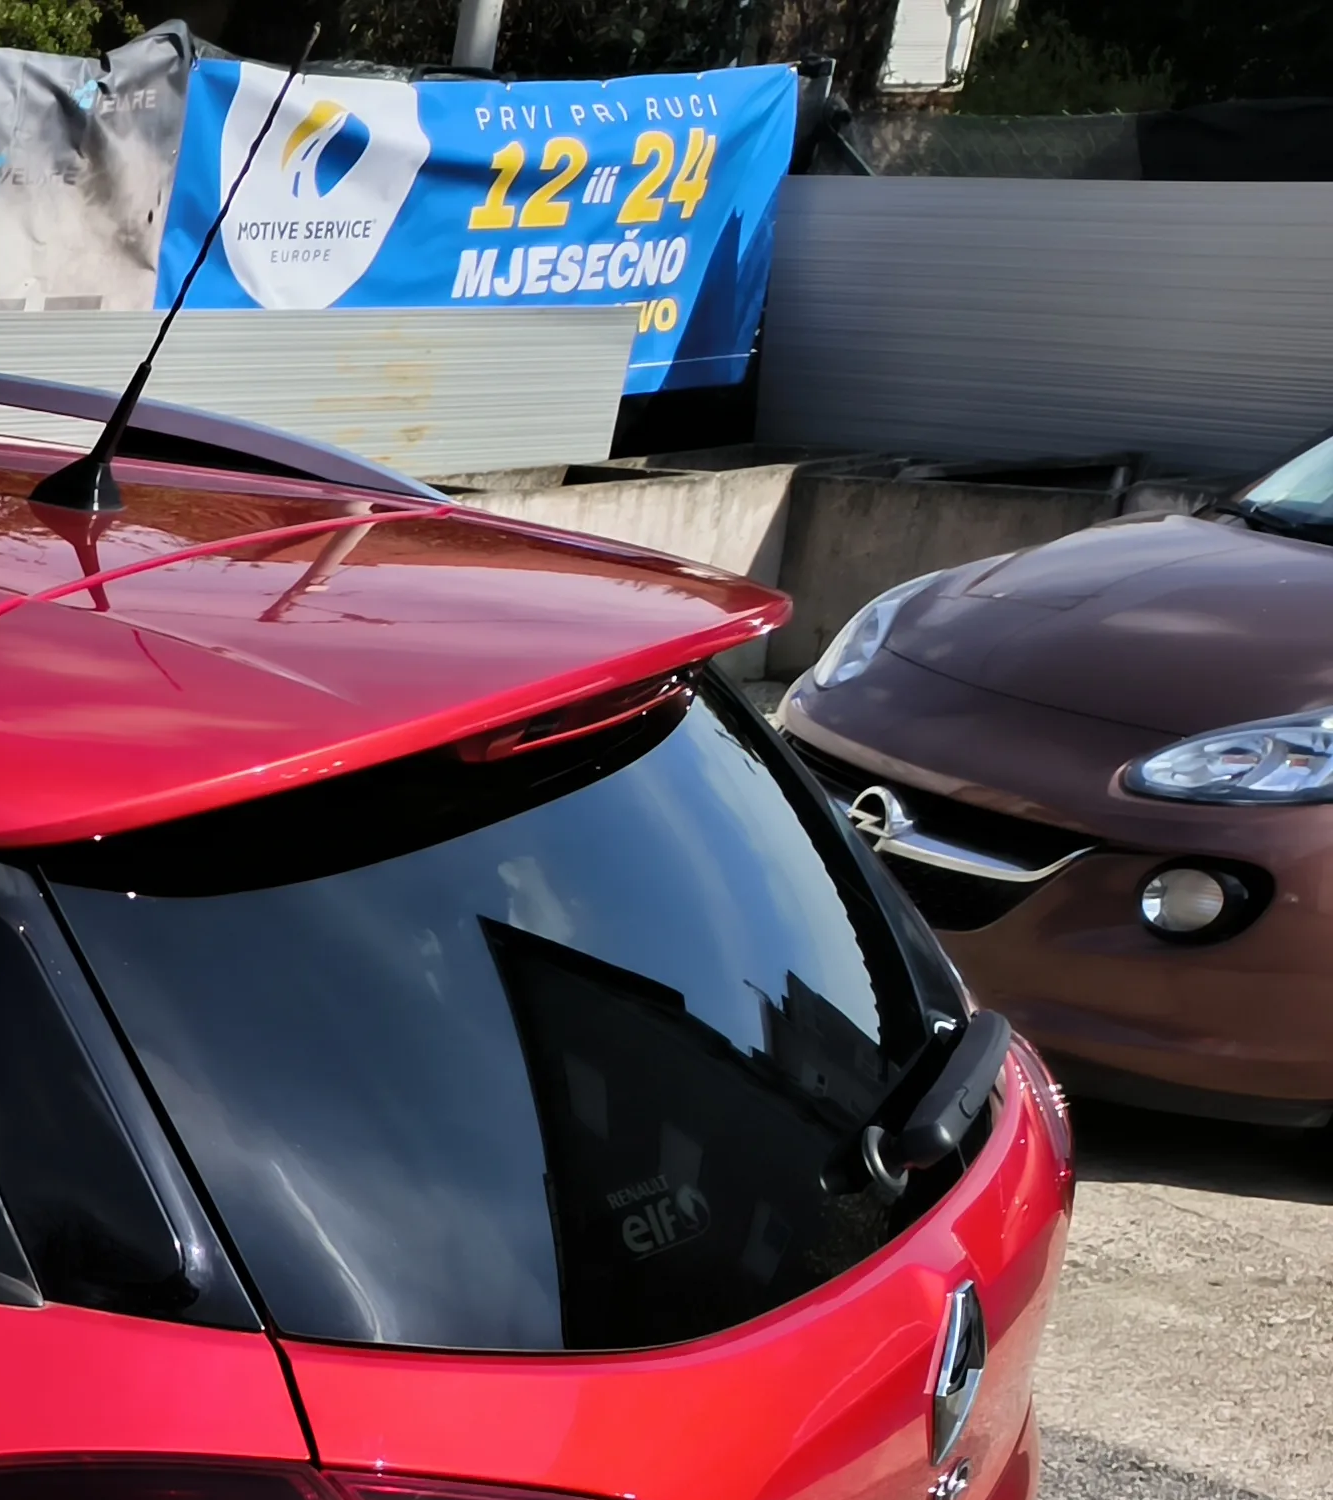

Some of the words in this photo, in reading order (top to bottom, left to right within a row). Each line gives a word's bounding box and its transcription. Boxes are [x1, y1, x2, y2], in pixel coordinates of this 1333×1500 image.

[474, 104, 553, 131] PRVI
[569, 101, 630, 127] PRI
[645, 93, 719, 121] RUCI
[468, 135, 589, 230] 12
[581, 164, 622, 204] ili
[615, 126, 717, 224] 24
[237, 220, 300, 241] MOTIVE
[303, 219, 373, 240] SERVICE
[270, 248, 332, 264] EUROPE
[450, 228, 686, 299] MJESEČNO
[605, 1174, 670, 1210] RENAULT
[621, 1196, 677, 1253] elf
